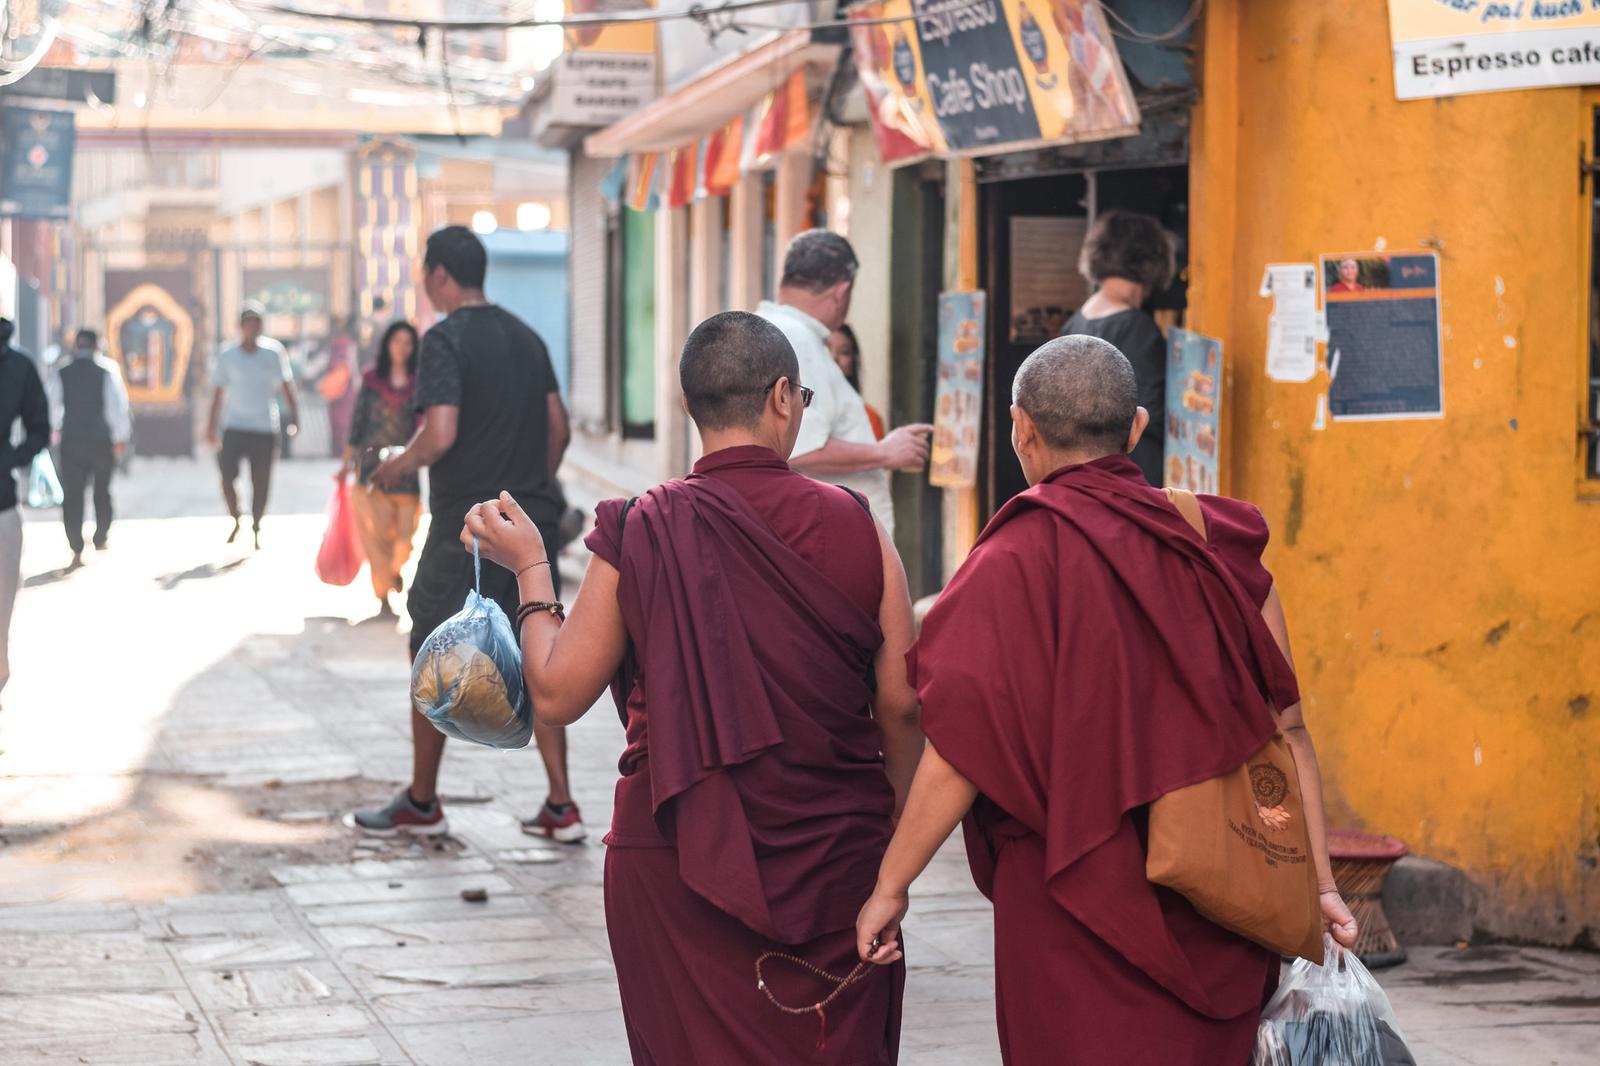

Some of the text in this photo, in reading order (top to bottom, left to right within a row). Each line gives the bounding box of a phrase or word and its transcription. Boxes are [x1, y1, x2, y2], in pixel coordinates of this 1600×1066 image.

[913, 0, 998, 47] Espresso
[1413, 50, 1540, 77] Espresso
[927, 68, 974, 117] Cafe
[969, 61, 1027, 114] Shop
